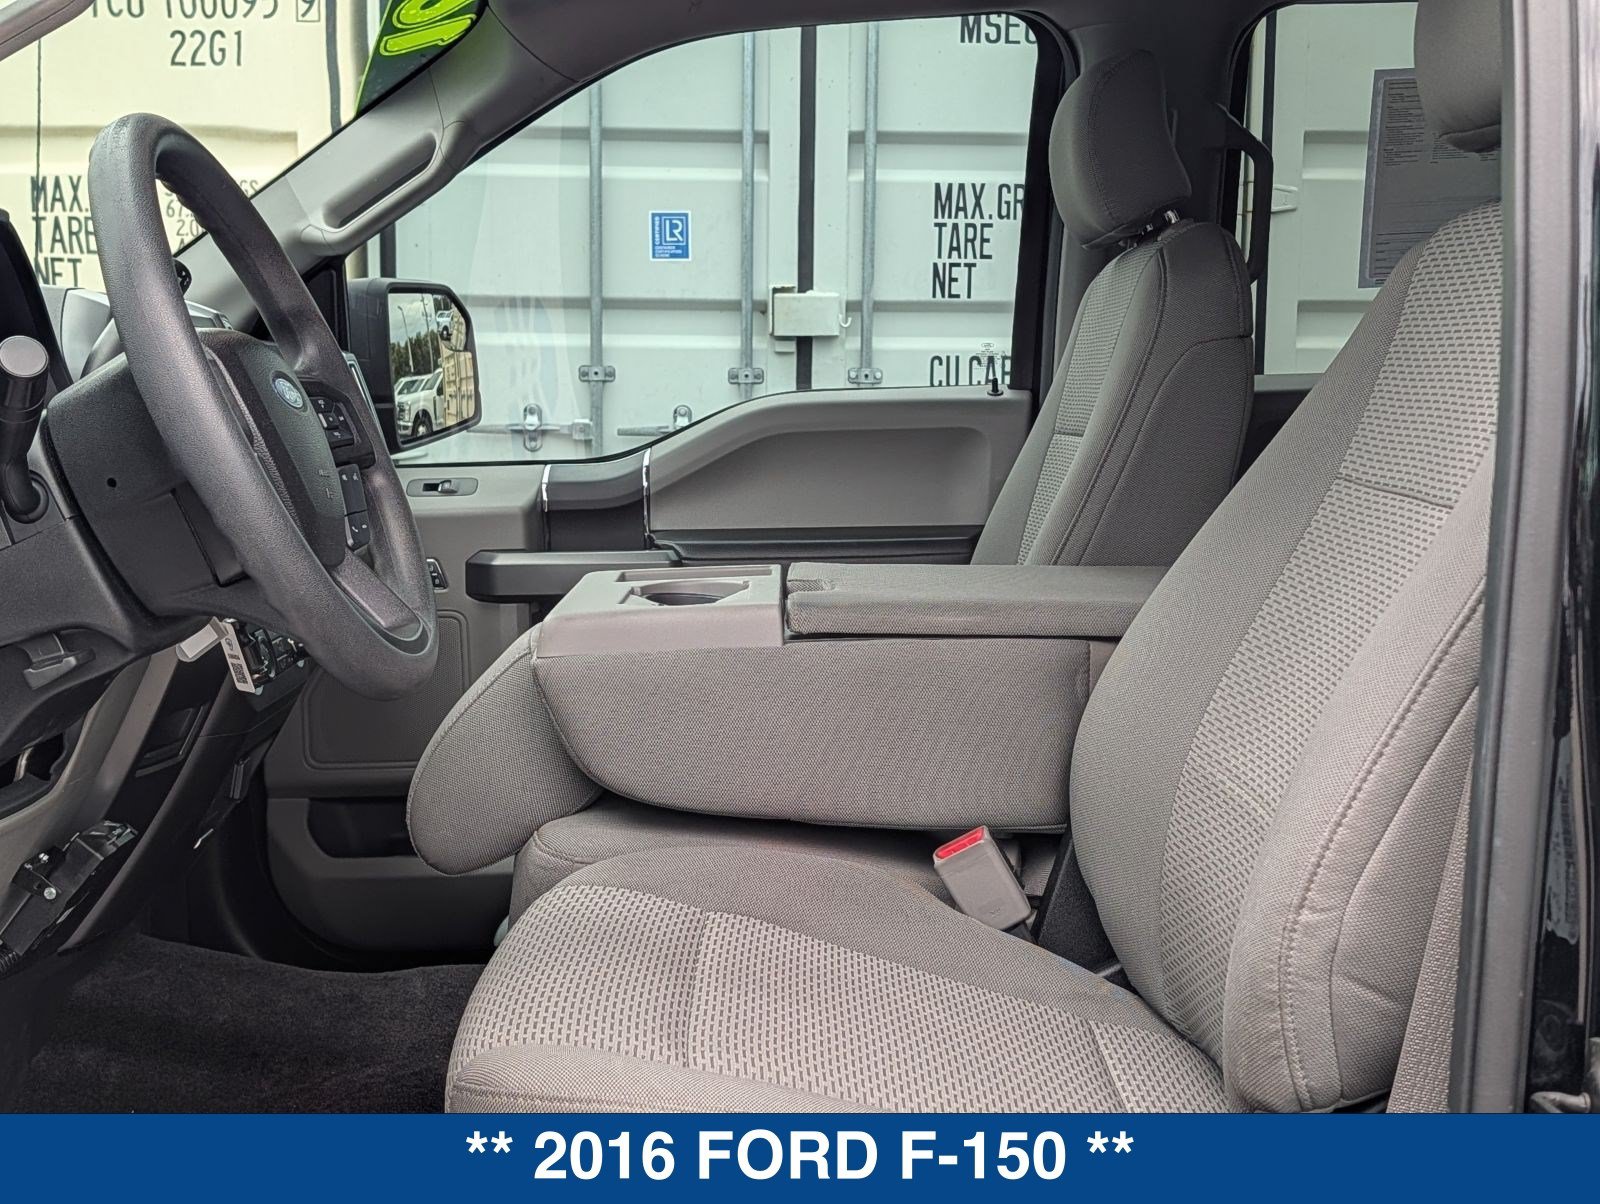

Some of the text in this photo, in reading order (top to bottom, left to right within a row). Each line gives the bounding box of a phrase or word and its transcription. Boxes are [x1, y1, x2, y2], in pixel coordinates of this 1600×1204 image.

[170, 29, 242, 67] 22G1
[665, 219, 683, 241] LR
[933, 222, 993, 260] TARE
[932, 262, 977, 299] NET
